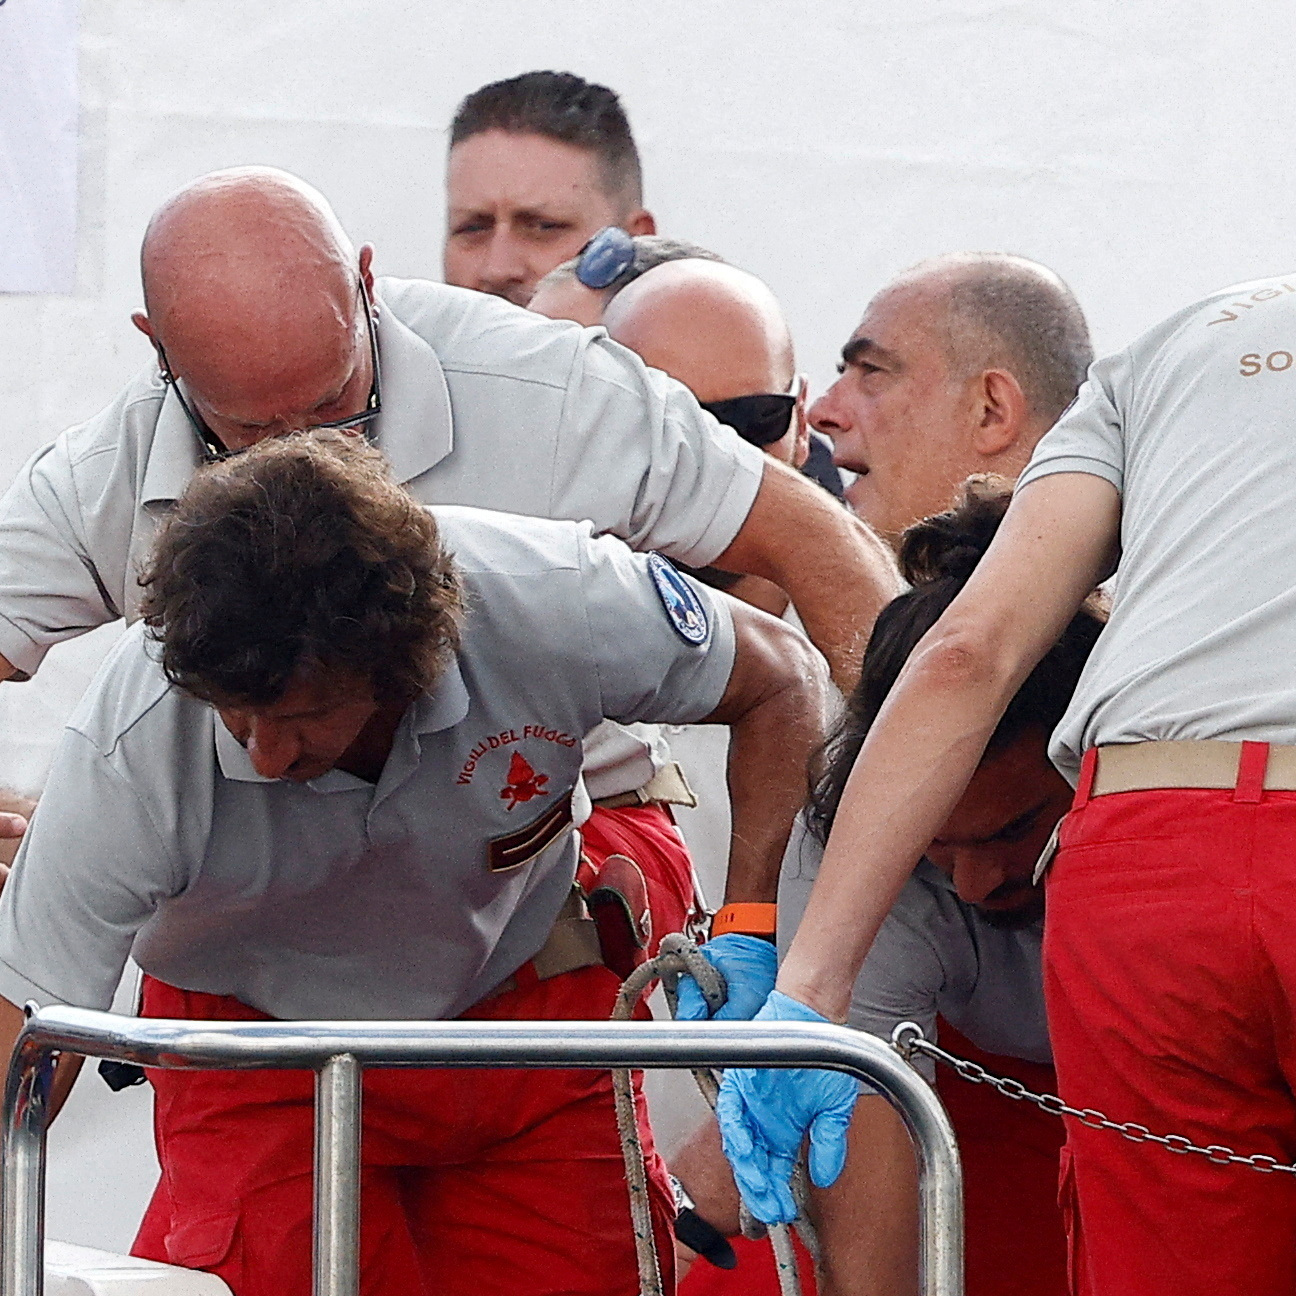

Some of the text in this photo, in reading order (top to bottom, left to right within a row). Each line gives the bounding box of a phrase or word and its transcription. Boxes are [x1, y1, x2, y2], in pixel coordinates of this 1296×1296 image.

[456, 725, 577, 785] VIGILI DEL FUOCO
